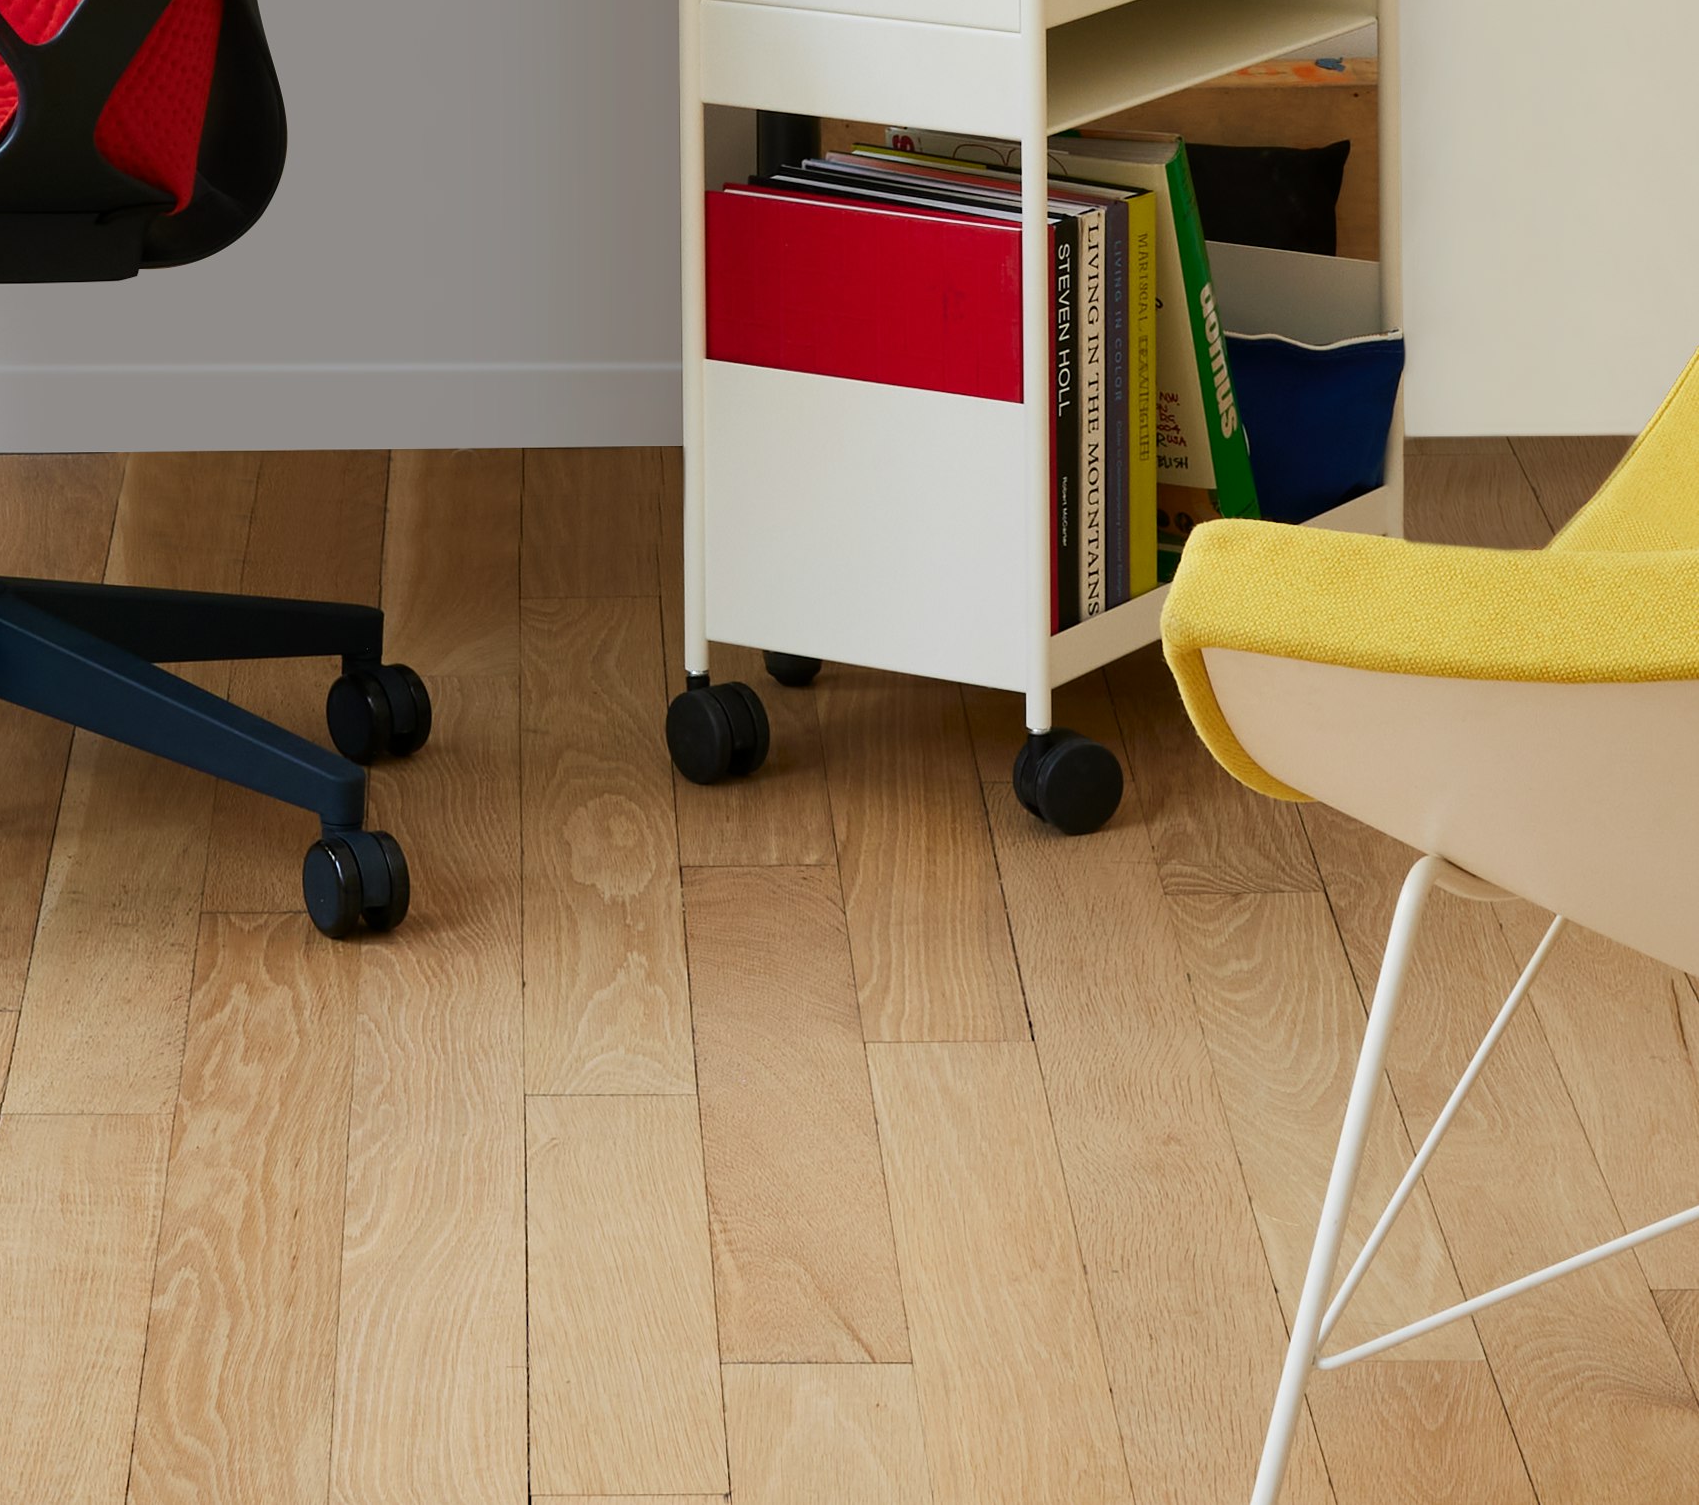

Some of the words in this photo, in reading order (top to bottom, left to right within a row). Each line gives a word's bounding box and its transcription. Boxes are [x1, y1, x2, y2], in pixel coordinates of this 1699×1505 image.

[1057, 242, 1071, 342] STEVEN
[1087, 225, 1100, 324] LIVING
[1114, 240, 1123, 303] LIVING
[1087, 336, 1100, 364] IN
[1114, 311, 1123, 330] IN
[1057, 348, 1071, 418] HOLL
[1114, 337, 1123, 402] COLOR
[1087, 372, 1100, 434] THE
[1087, 443, 1100, 617] MOUNTAINS
